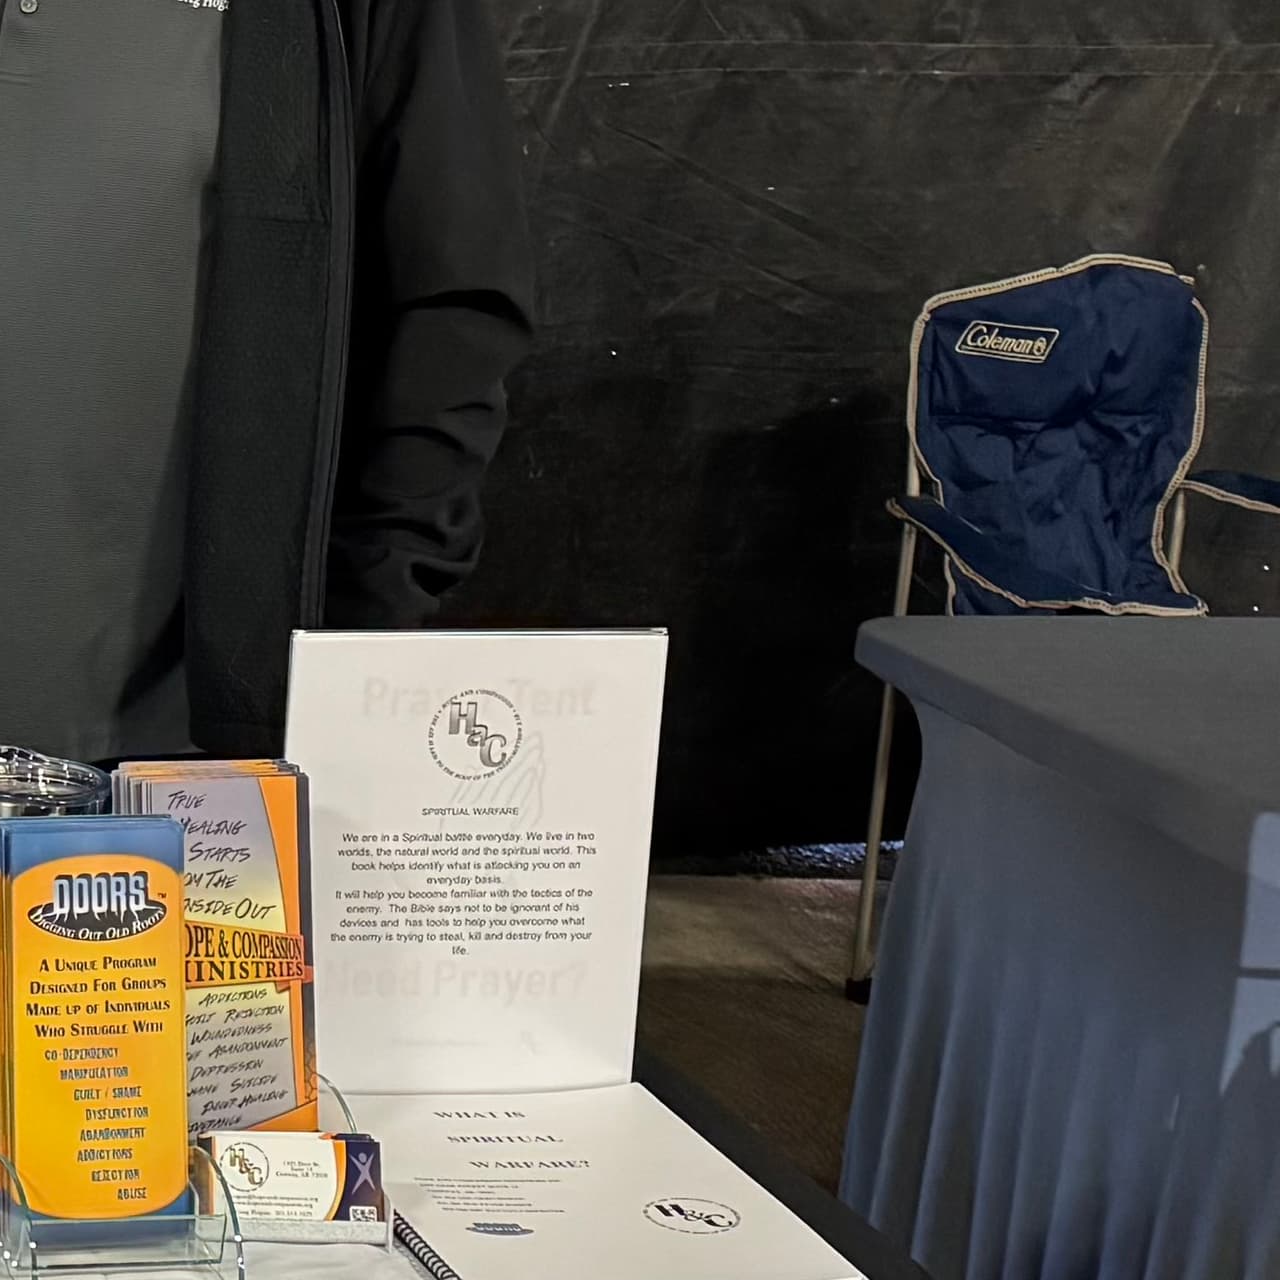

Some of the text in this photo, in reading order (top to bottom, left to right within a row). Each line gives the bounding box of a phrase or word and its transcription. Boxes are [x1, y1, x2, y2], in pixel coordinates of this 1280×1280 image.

[965, 325, 1033, 353] Coleman
[167, 790, 207, 810] TRUE
[472, 806, 519, 817] WARFARE
[341, 832, 359, 844] We
[380, 833, 390, 843] in
[525, 830, 543, 842] We
[564, 831, 575, 841] in
[188, 841, 251, 863] STARTS
[206, 869, 239, 890] THE
[53, 870, 149, 917] DOORS
[234, 897, 277, 920] OUT
[78, 927, 104, 941] OUT
[105, 926, 131, 940] OLD
[218, 928, 304, 961] & COMPASSION
[39, 955, 157, 973] A UNIQUE PROGRAM
[29, 976, 167, 995] DESIGNED FOR GROUPS
[26, 1000, 171, 1017] MADE UP OF INDIVIDUALS
[35, 1020, 164, 1038] WHO STRUGGLE WITH
